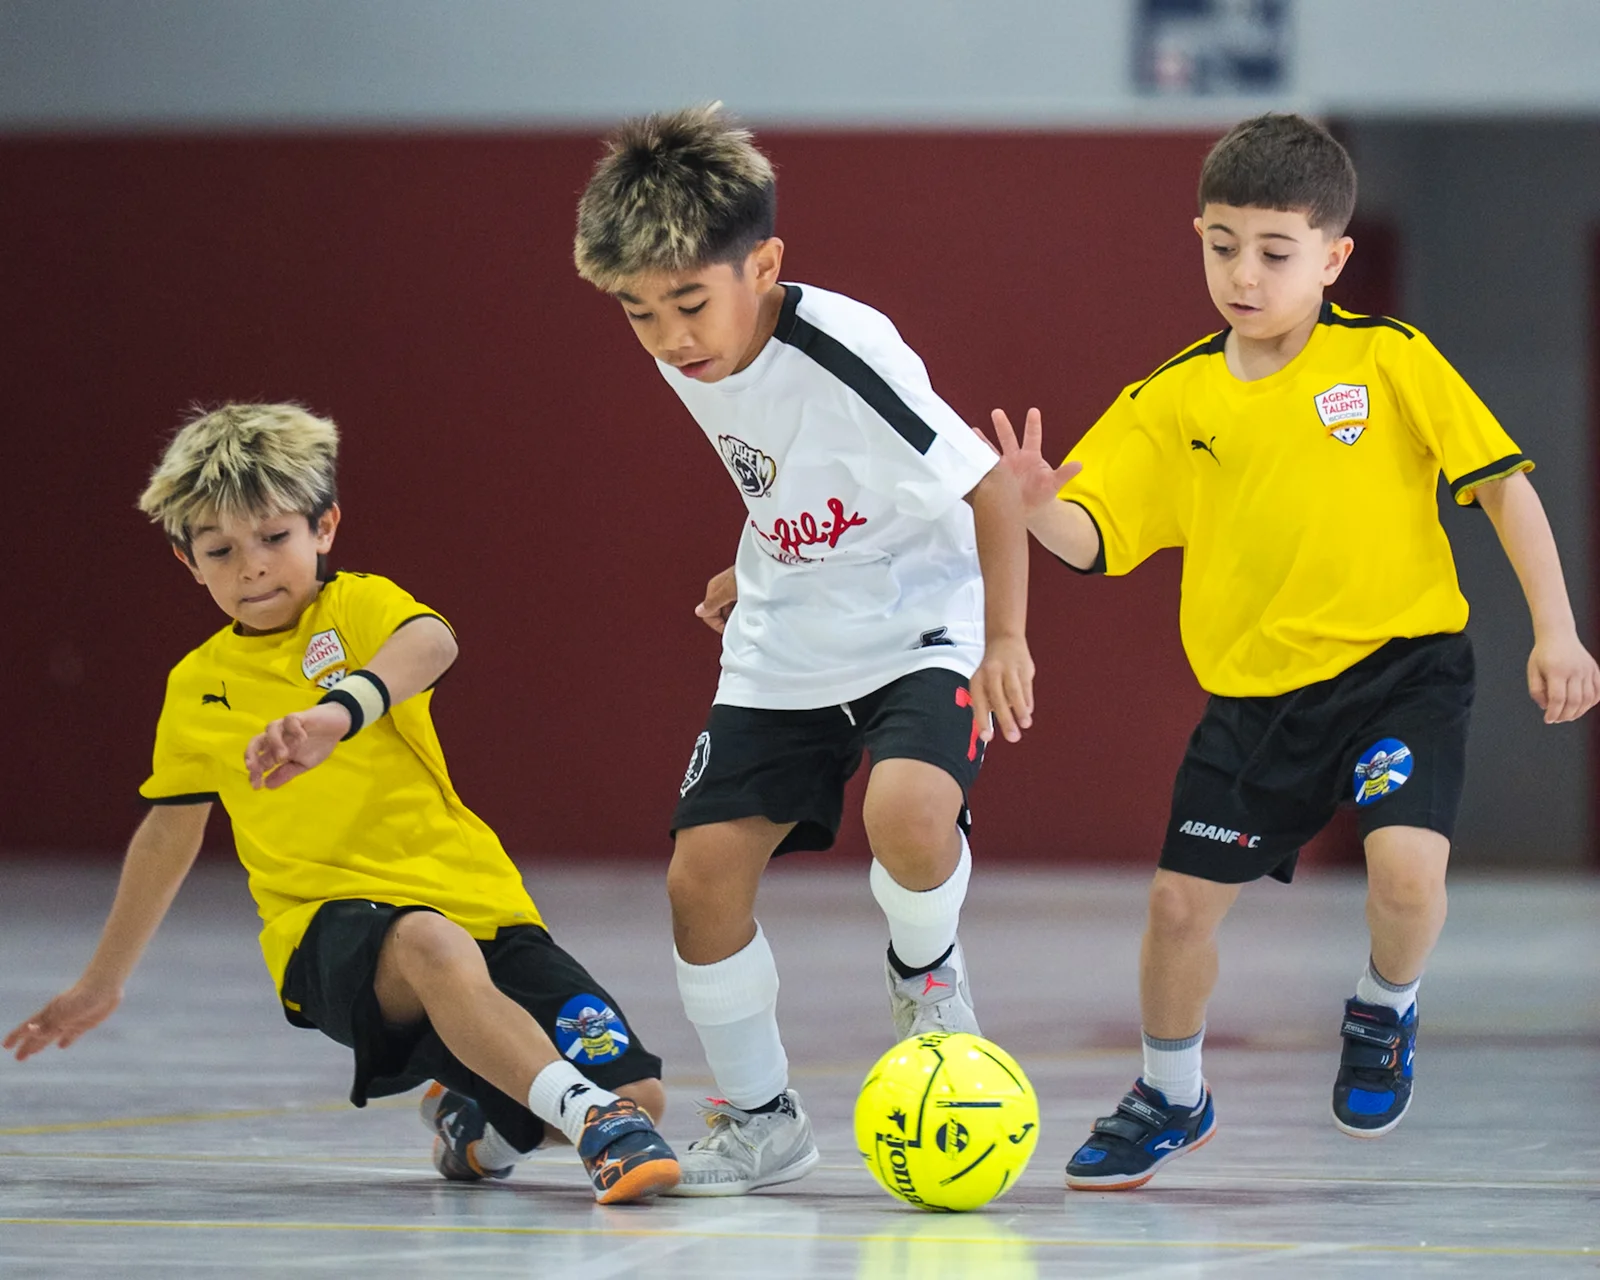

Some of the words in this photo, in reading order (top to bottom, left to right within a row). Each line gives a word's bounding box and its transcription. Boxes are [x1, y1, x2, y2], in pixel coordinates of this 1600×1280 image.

[1322, 388, 1361, 405] AGENCY
[1323, 399, 1364, 415] TALENTS
[304, 642, 339, 669] TALENTS
